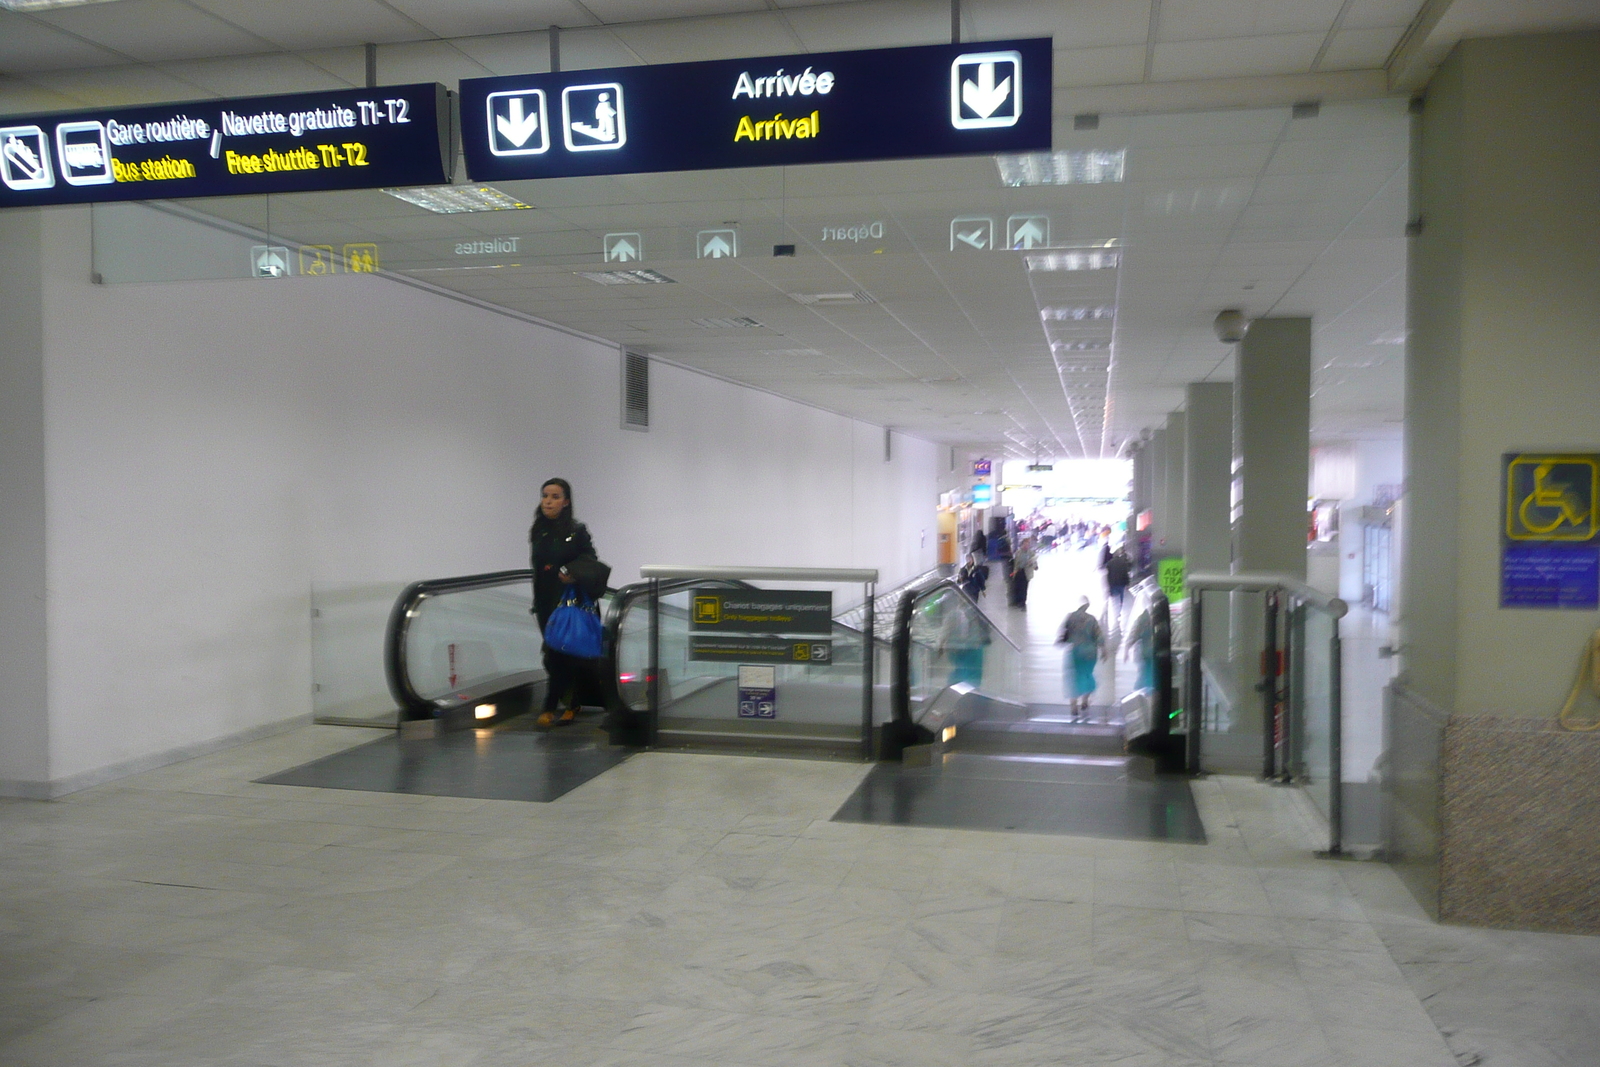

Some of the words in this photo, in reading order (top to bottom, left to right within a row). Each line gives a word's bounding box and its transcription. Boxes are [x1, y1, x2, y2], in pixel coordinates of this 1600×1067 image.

[731, 65, 836, 100] Arrivée
[106, 118, 147, 146] Gare
[145, 114, 211, 143] routière
[221, 109, 289, 137] Navette
[288, 104, 358, 137] gratuite
[357, 98, 411, 126] T1-T2
[734, 110, 820, 142] Arrival
[110, 157, 144, 182] Bus
[140, 154, 197, 181] station
[225, 150, 265, 175] Free
[262, 147, 320, 173] shuttle
[317, 142, 370, 168] T1-T2
